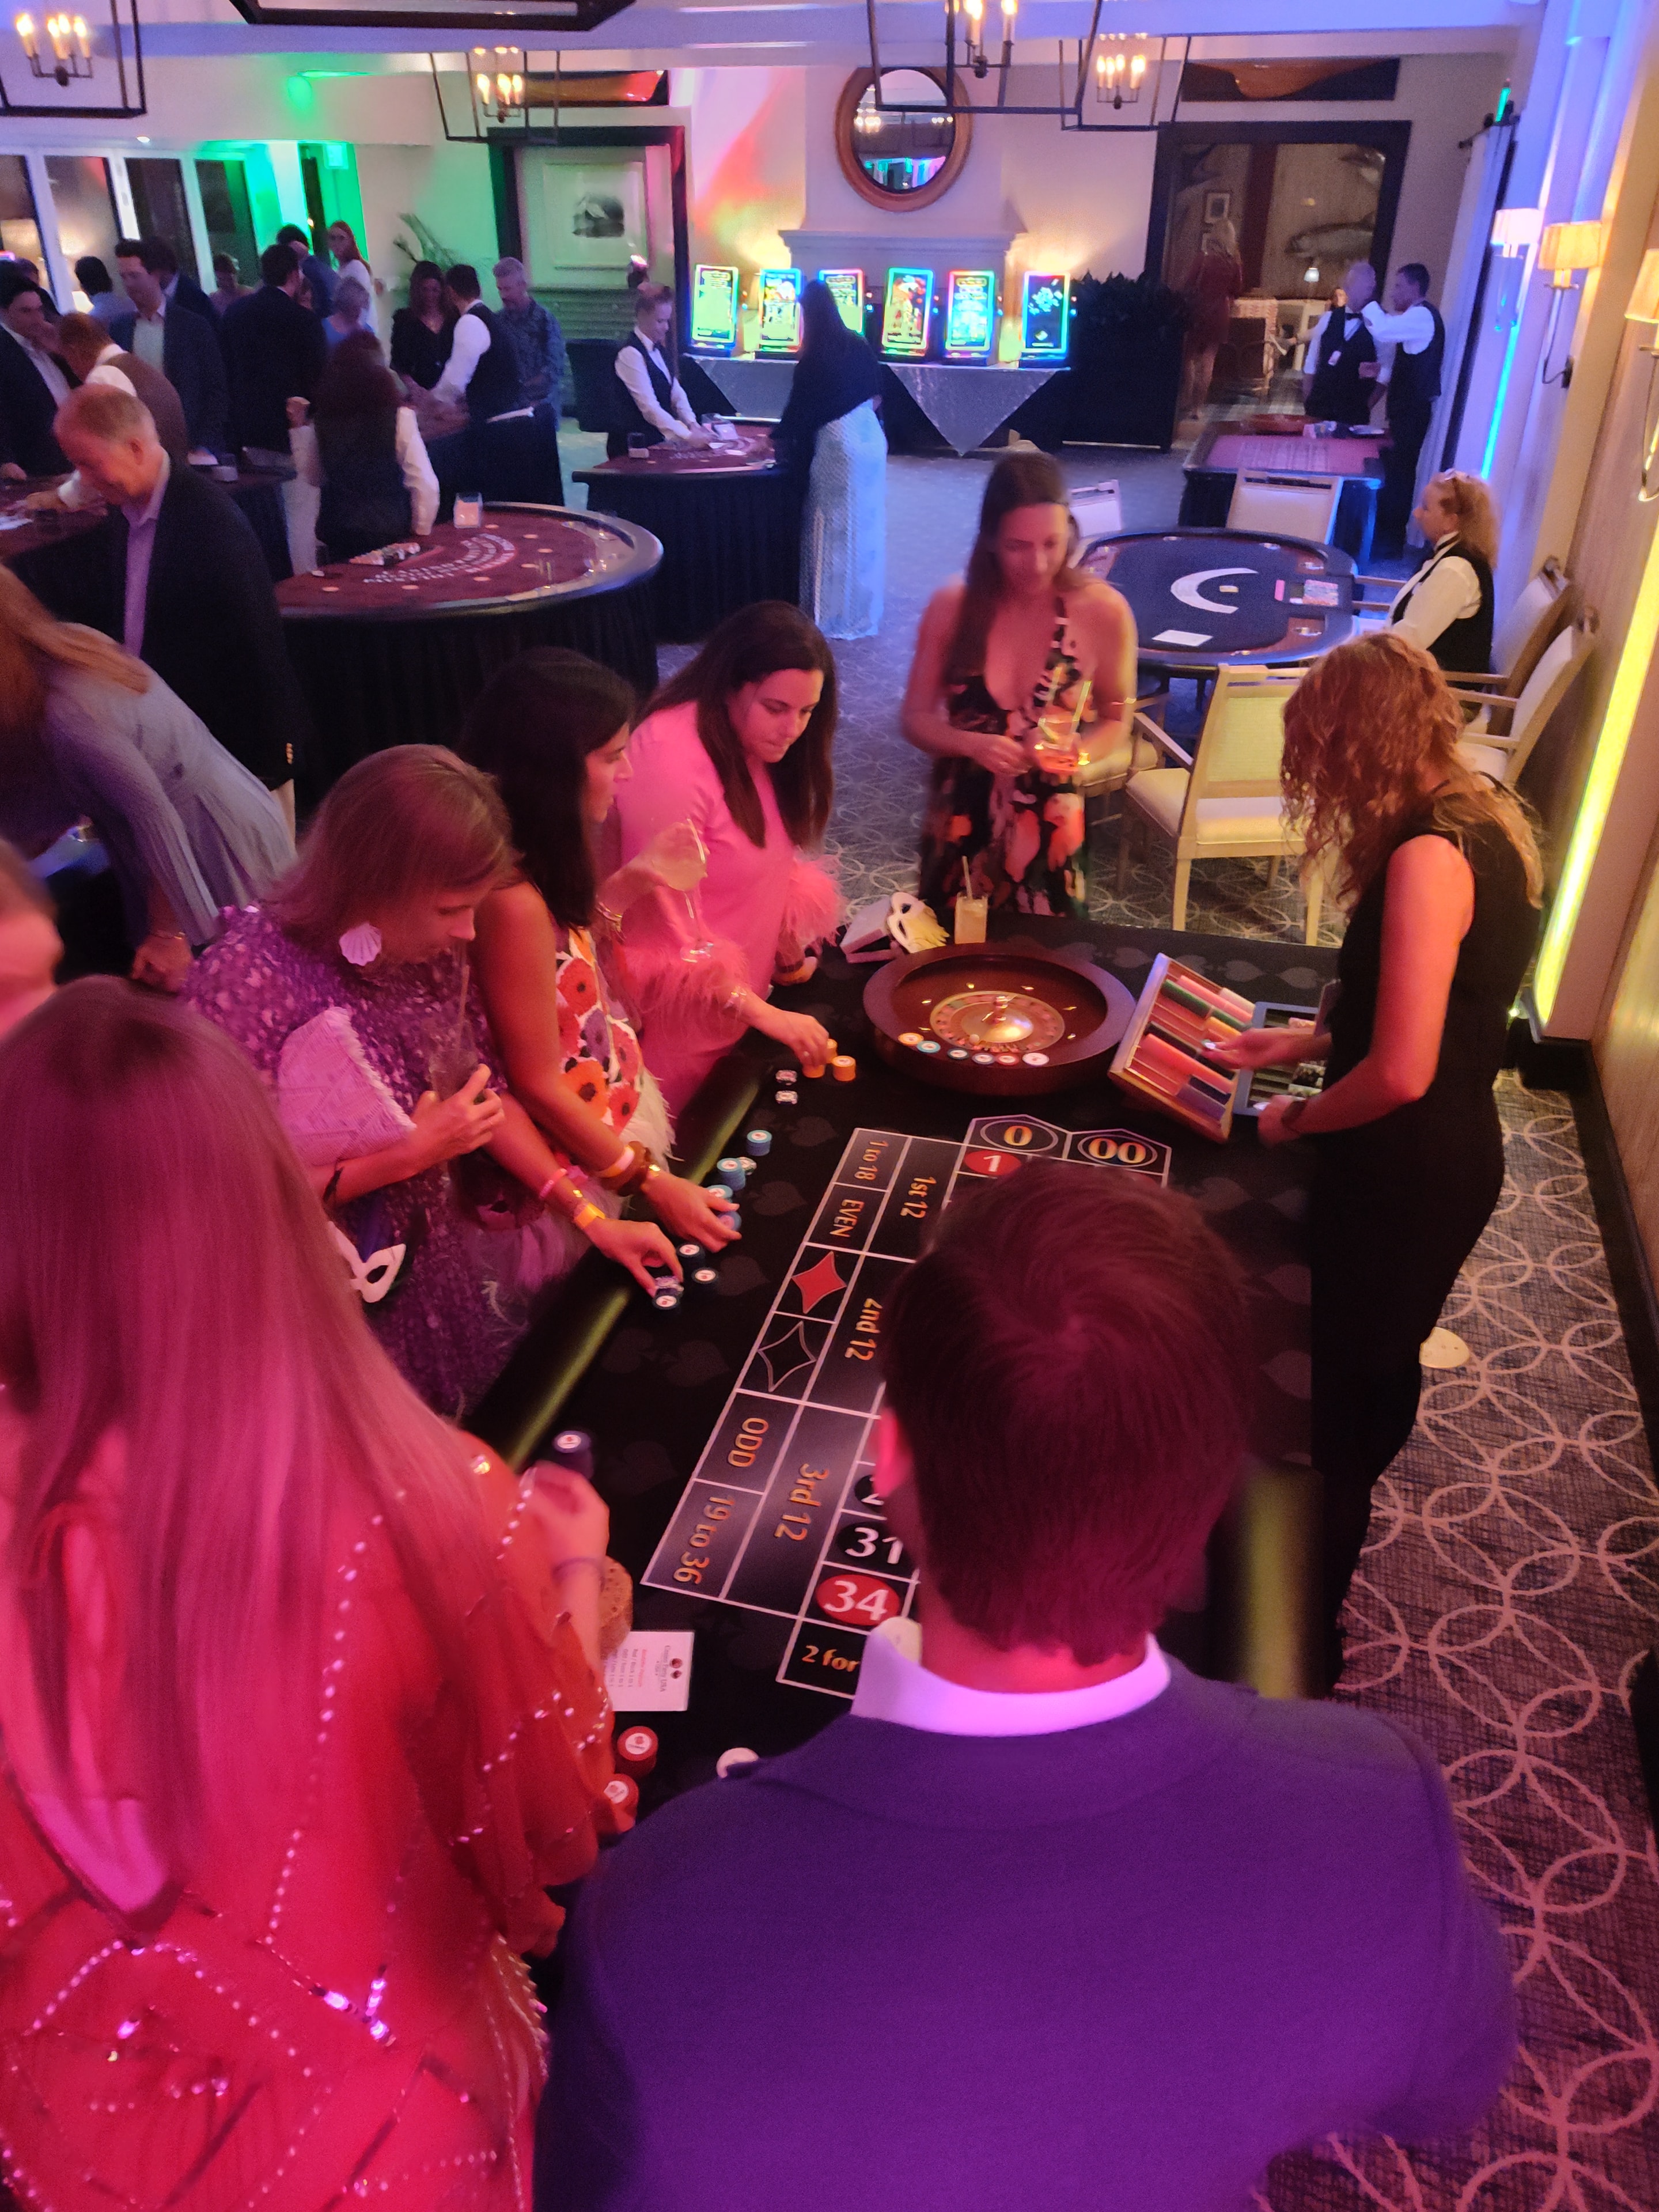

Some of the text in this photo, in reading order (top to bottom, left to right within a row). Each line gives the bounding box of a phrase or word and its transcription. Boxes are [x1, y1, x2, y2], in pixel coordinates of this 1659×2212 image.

[1003, 1126, 1032, 1146] 0
[1089, 1138, 1146, 1164] 00
[862, 1149, 881, 1162] to
[983, 1155, 1001, 1172] 1
[854, 1165, 878, 1180] 18
[900, 1176, 937, 1218] 1st 12
[830, 1199, 864, 1237] EVEN
[844, 1339, 877, 1360] 12
[728, 1418, 769, 1467] ODD
[774, 1463, 829, 1541] 3rd 12
[673, 1495, 735, 1584] 19 to 36
[844, 1527, 903, 1564] 31
[824, 1580, 889, 1621] 34
[801, 1645, 859, 1672] 2 for
